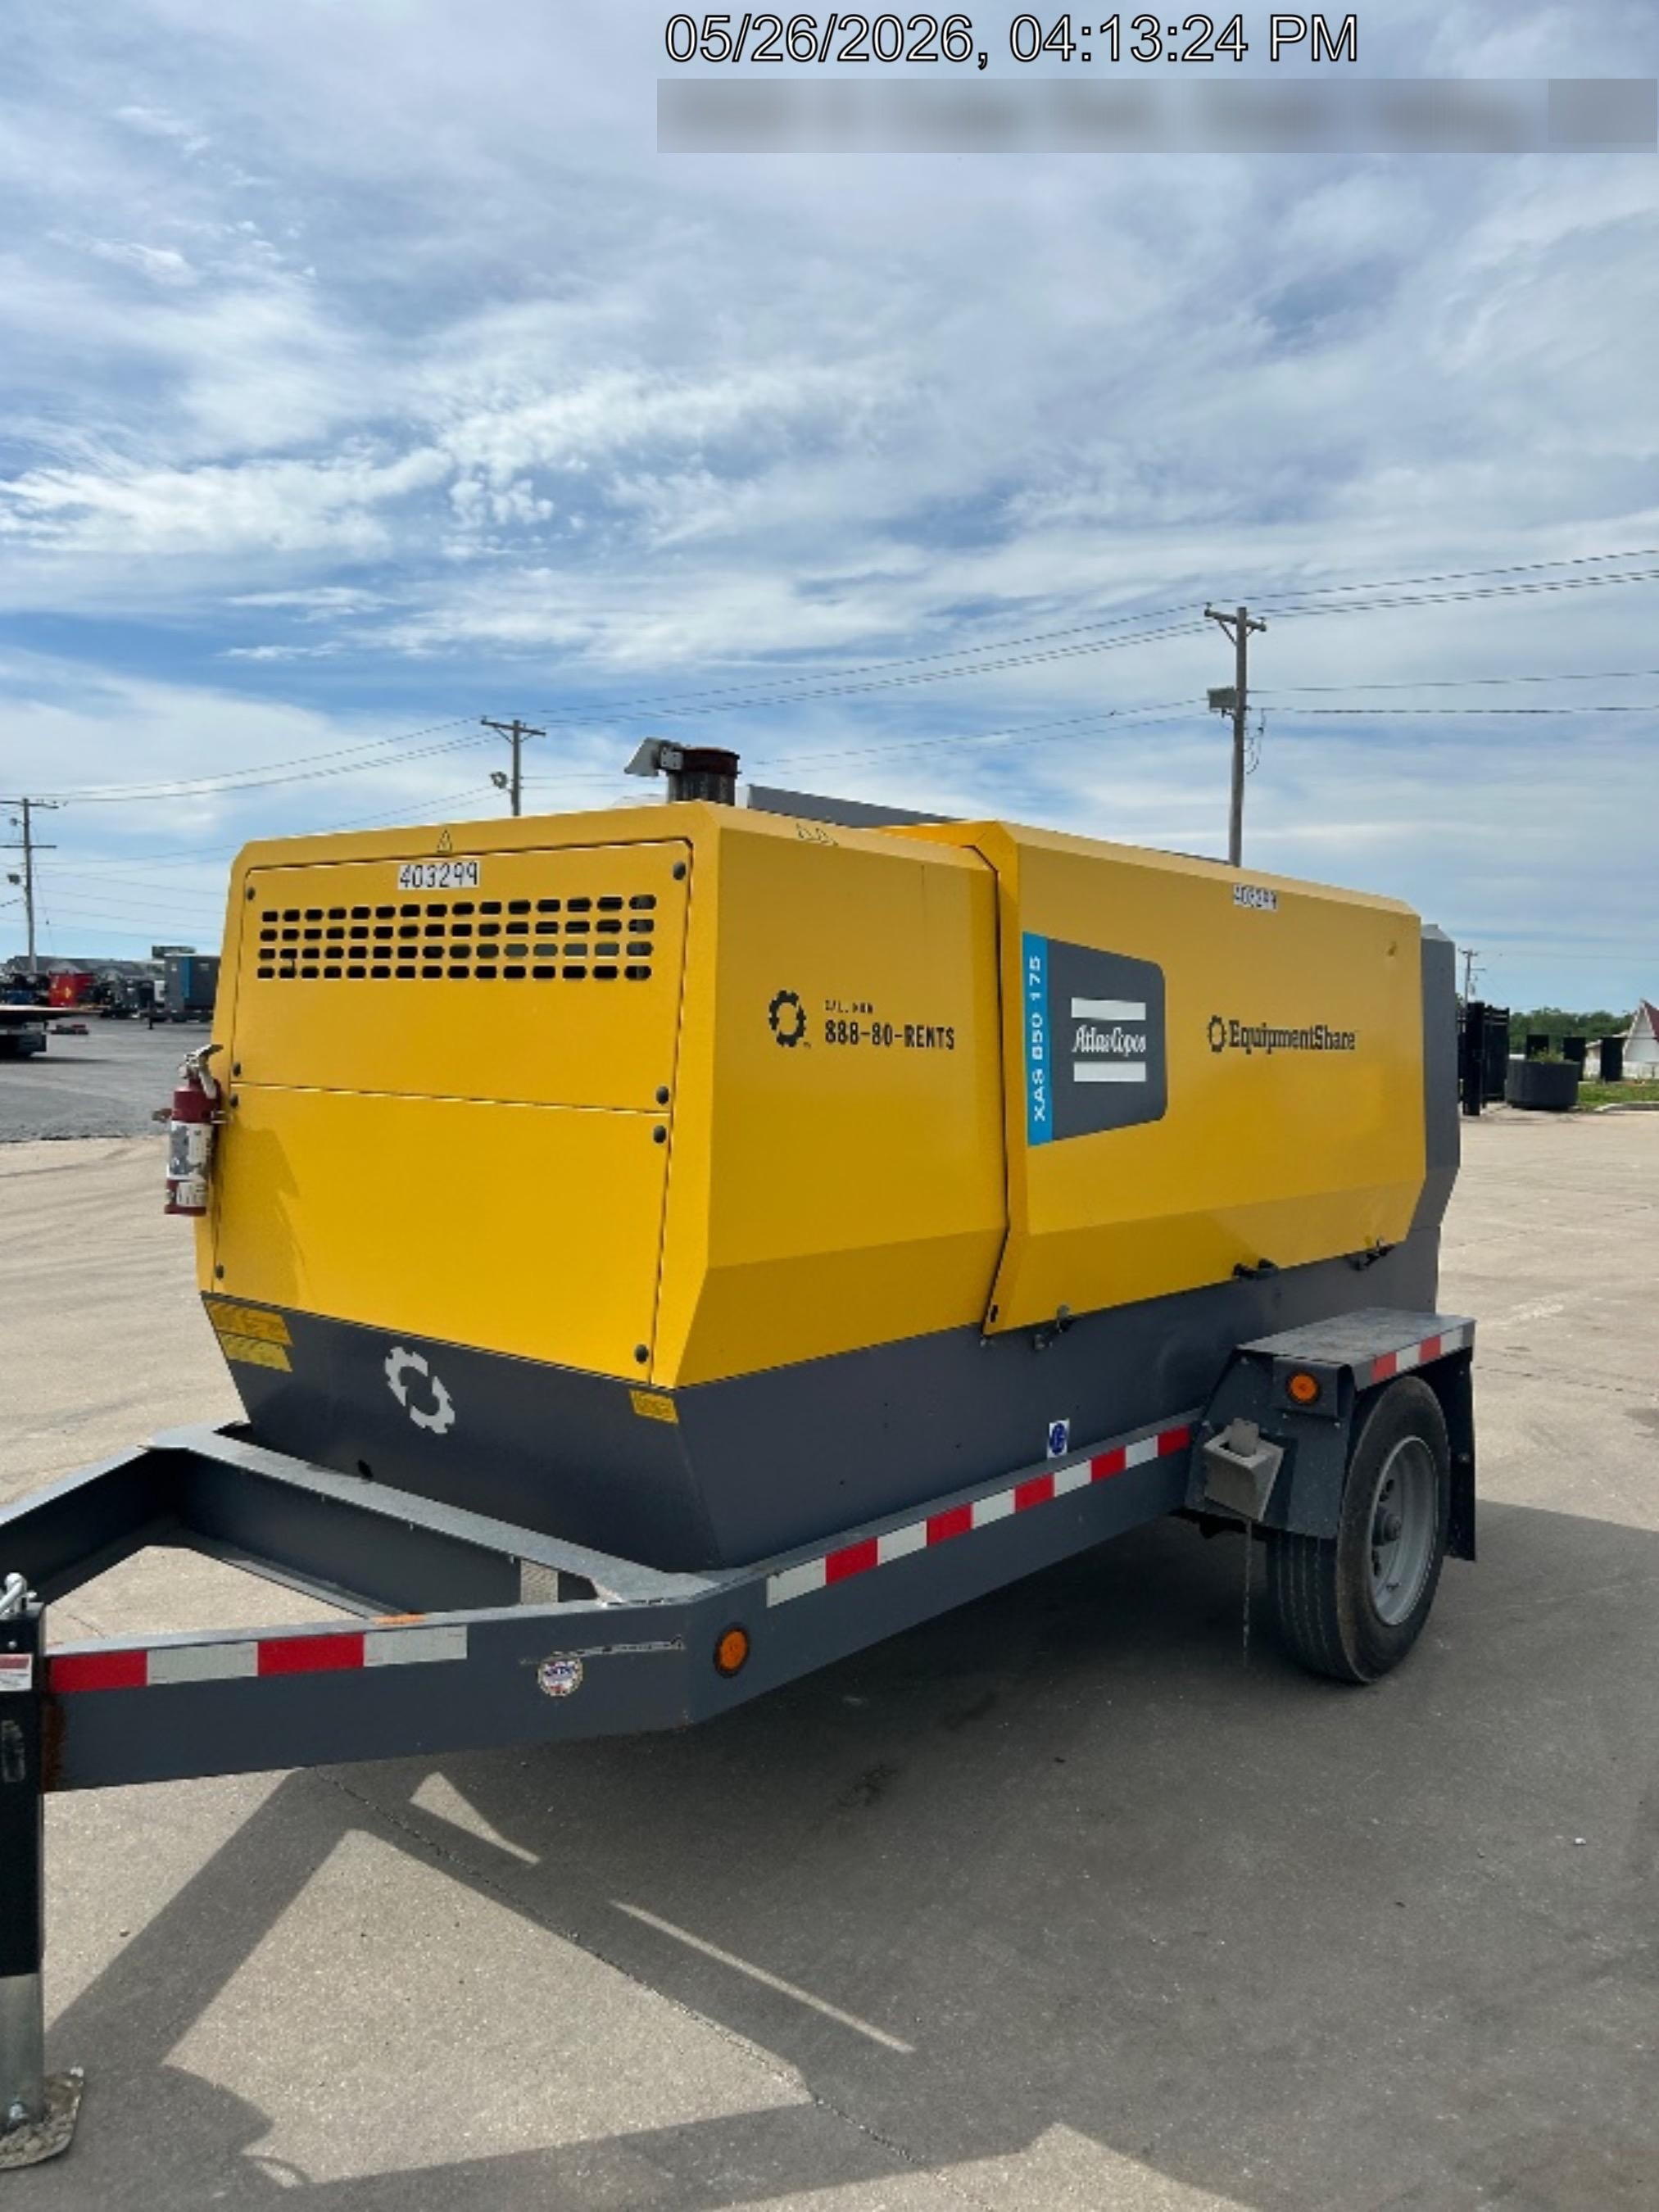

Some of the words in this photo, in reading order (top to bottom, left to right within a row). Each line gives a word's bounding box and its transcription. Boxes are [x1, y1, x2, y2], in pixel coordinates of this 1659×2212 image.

[400, 861, 478, 888] 403299
[1029, 955, 1041, 1001] 175
[1229, 1020, 1355, 1054] EquipmentShare
